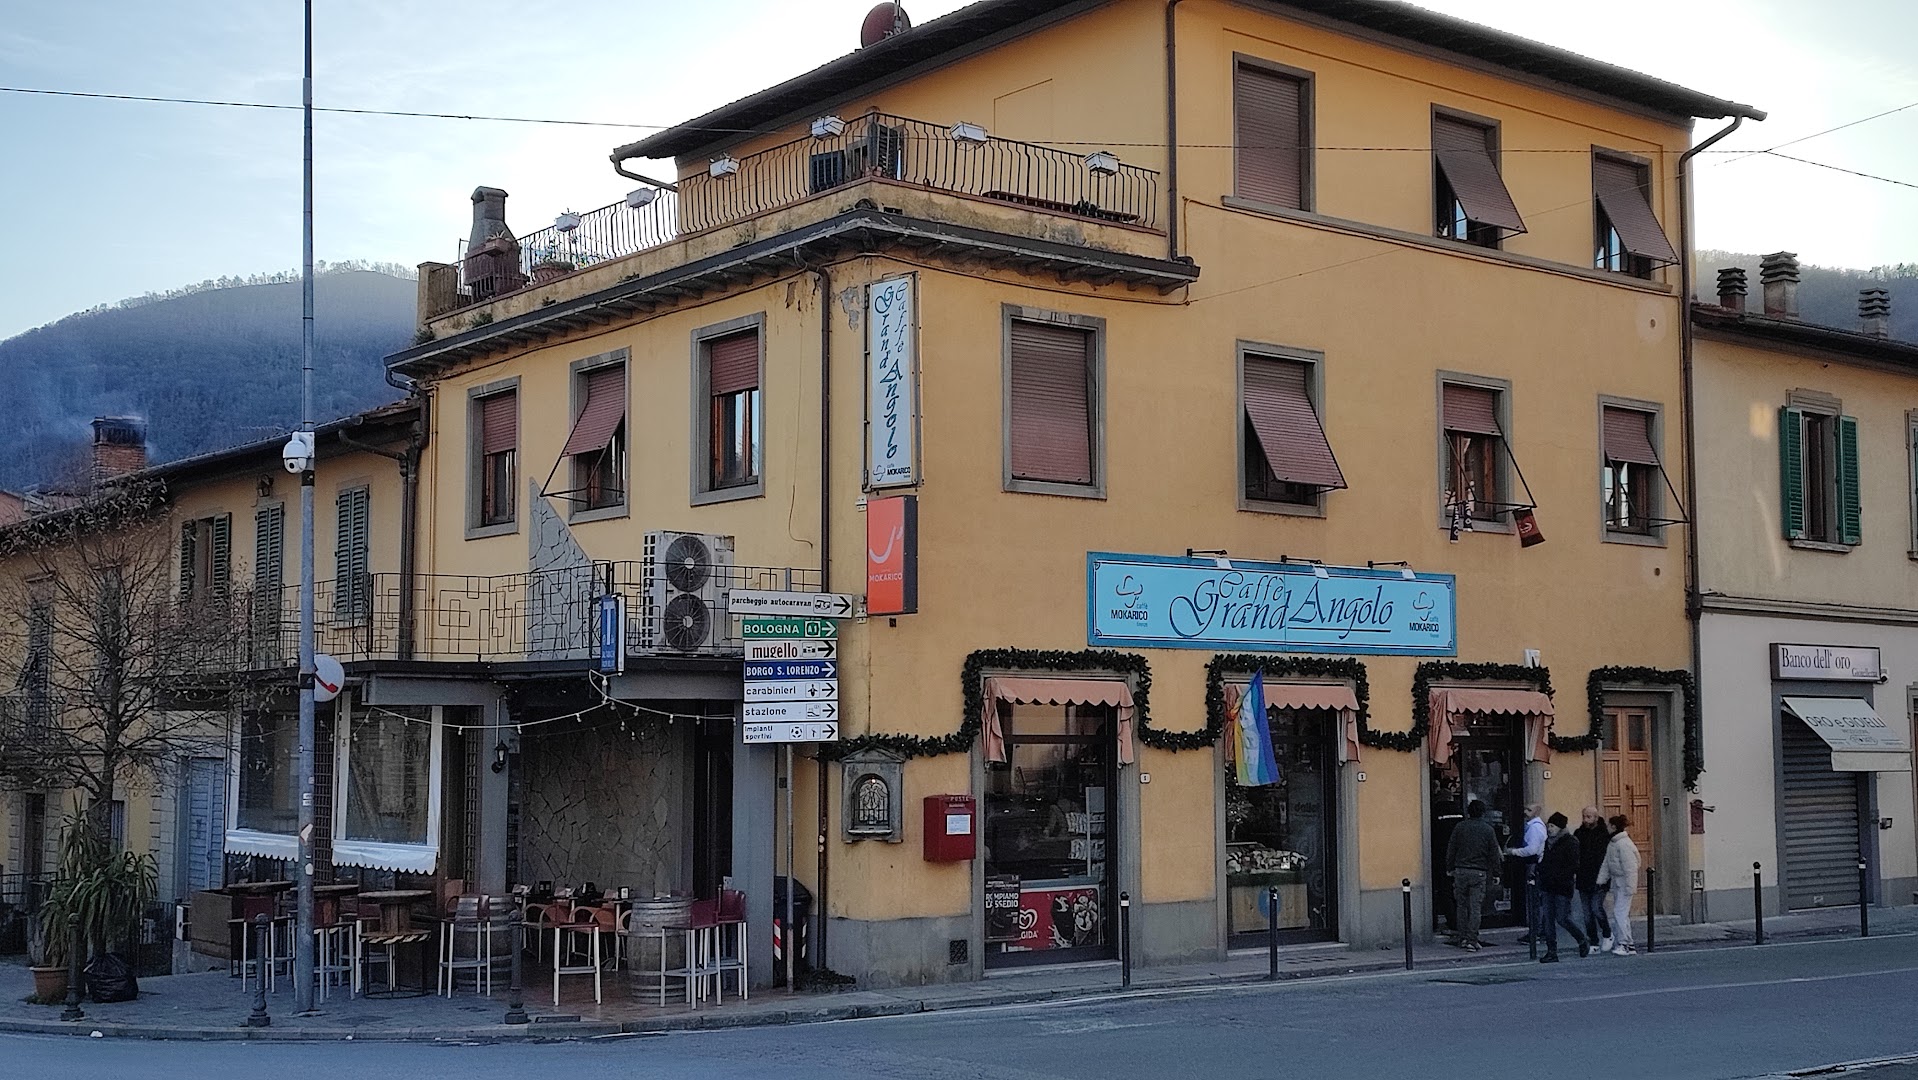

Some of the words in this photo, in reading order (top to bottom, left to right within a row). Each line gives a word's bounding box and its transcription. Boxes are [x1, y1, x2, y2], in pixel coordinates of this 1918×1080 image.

[886, 466, 911, 476] MOKARICO
[869, 572, 903, 582] MOKARICO
[1218, 571, 1285, 608] Caffè
[731, 596, 768, 607] parcheggio
[770, 597, 812, 607] autocaravan
[1169, 579, 1293, 638] Grand
[1288, 580, 1395, 639] Angolo
[1110, 609, 1148, 621] MOKARICO
[743, 624, 800, 634] BOLOGNA
[1409, 622, 1439, 633] MOKARICO
[752, 642, 798, 659] mugello
[1781, 647, 1812, 668] Banco
[1835, 656, 1851, 669] oro
[746, 666, 774, 676] BORGO
[777, 666, 785, 676] S.
[786, 665, 820, 675] LORENZO
[746, 686, 796, 695] carabinieri
[745, 707, 787, 716] stazione
[1805, 716, 1834, 727] ORO
[1834, 719, 1845, 728] e
[1842, 716, 1887, 728] GIOIELLI
[744, 725, 773, 733] impianti
